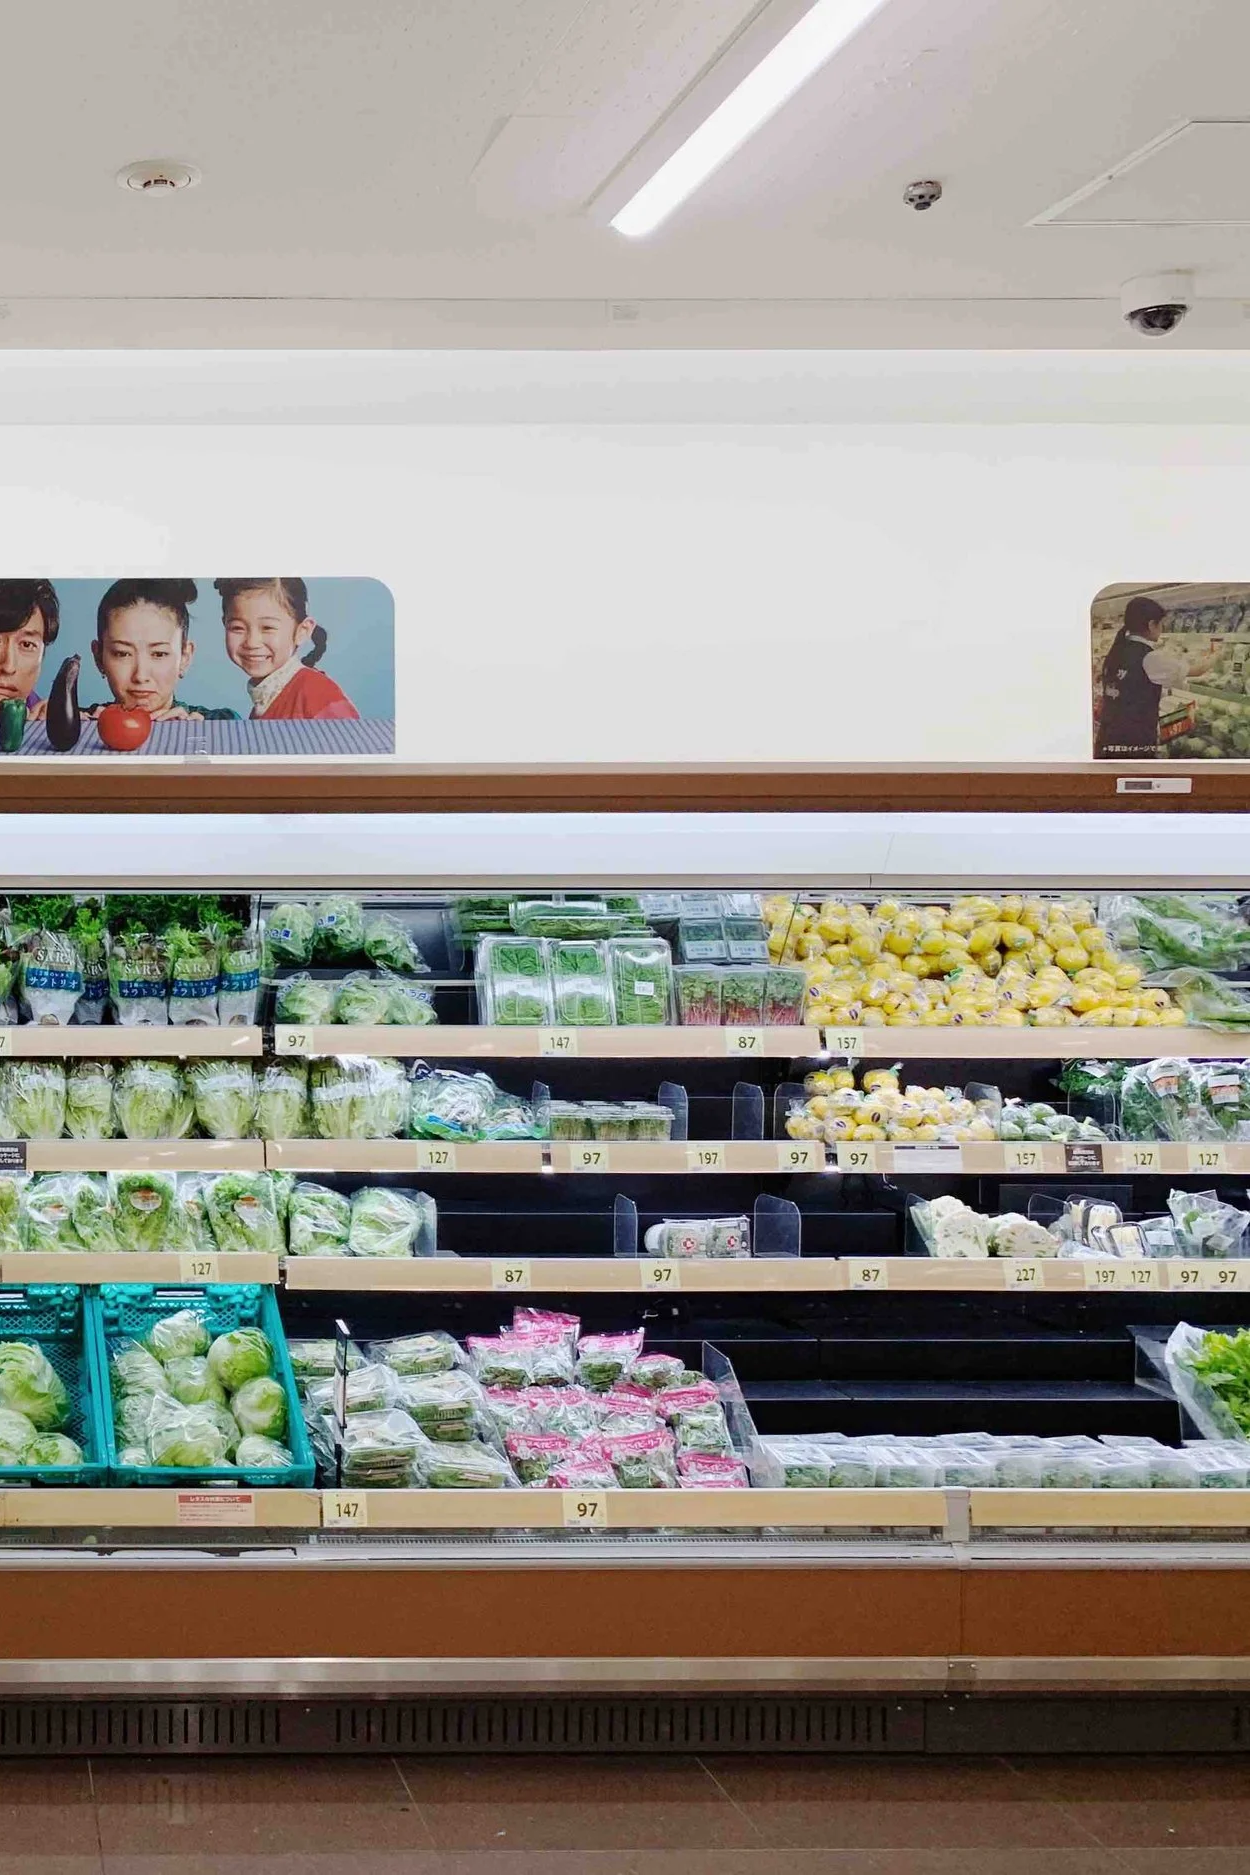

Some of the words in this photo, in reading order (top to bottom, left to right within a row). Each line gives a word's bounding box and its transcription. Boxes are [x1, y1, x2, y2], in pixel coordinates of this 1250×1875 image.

[29, 976, 78, 989] サラトリオ
[288, 1035, 306, 1048] 97
[550, 1036, 570, 1049] 147
[738, 1036, 756, 1049] 87
[837, 1037, 857, 1050] 157
[429, 1151, 449, 1164] 127
[582, 1152, 601, 1165] 97
[698, 1152, 718, 1165] 197
[790, 1151, 809, 1164] 97
[850, 1152, 868, 1166] 97
[1133, 1152, 1154, 1166] 127
[1199, 1153, 1219, 1166] 127
[191, 1262, 212, 1276] 127
[653, 1268, 672, 1282] 97
[862, 1269, 880, 1282] 87
[1016, 1267, 1037, 1283] 227
[505, 1269, 523, 1283] 87
[1095, 1270, 1116, 1283] 197
[1131, 1270, 1152, 1283] 127
[1180, 1270, 1199, 1284] 97
[1218, 1270, 1237, 1284] 97
[336, 1503, 359, 1518] 147
[577, 1502, 598, 1518] 97
